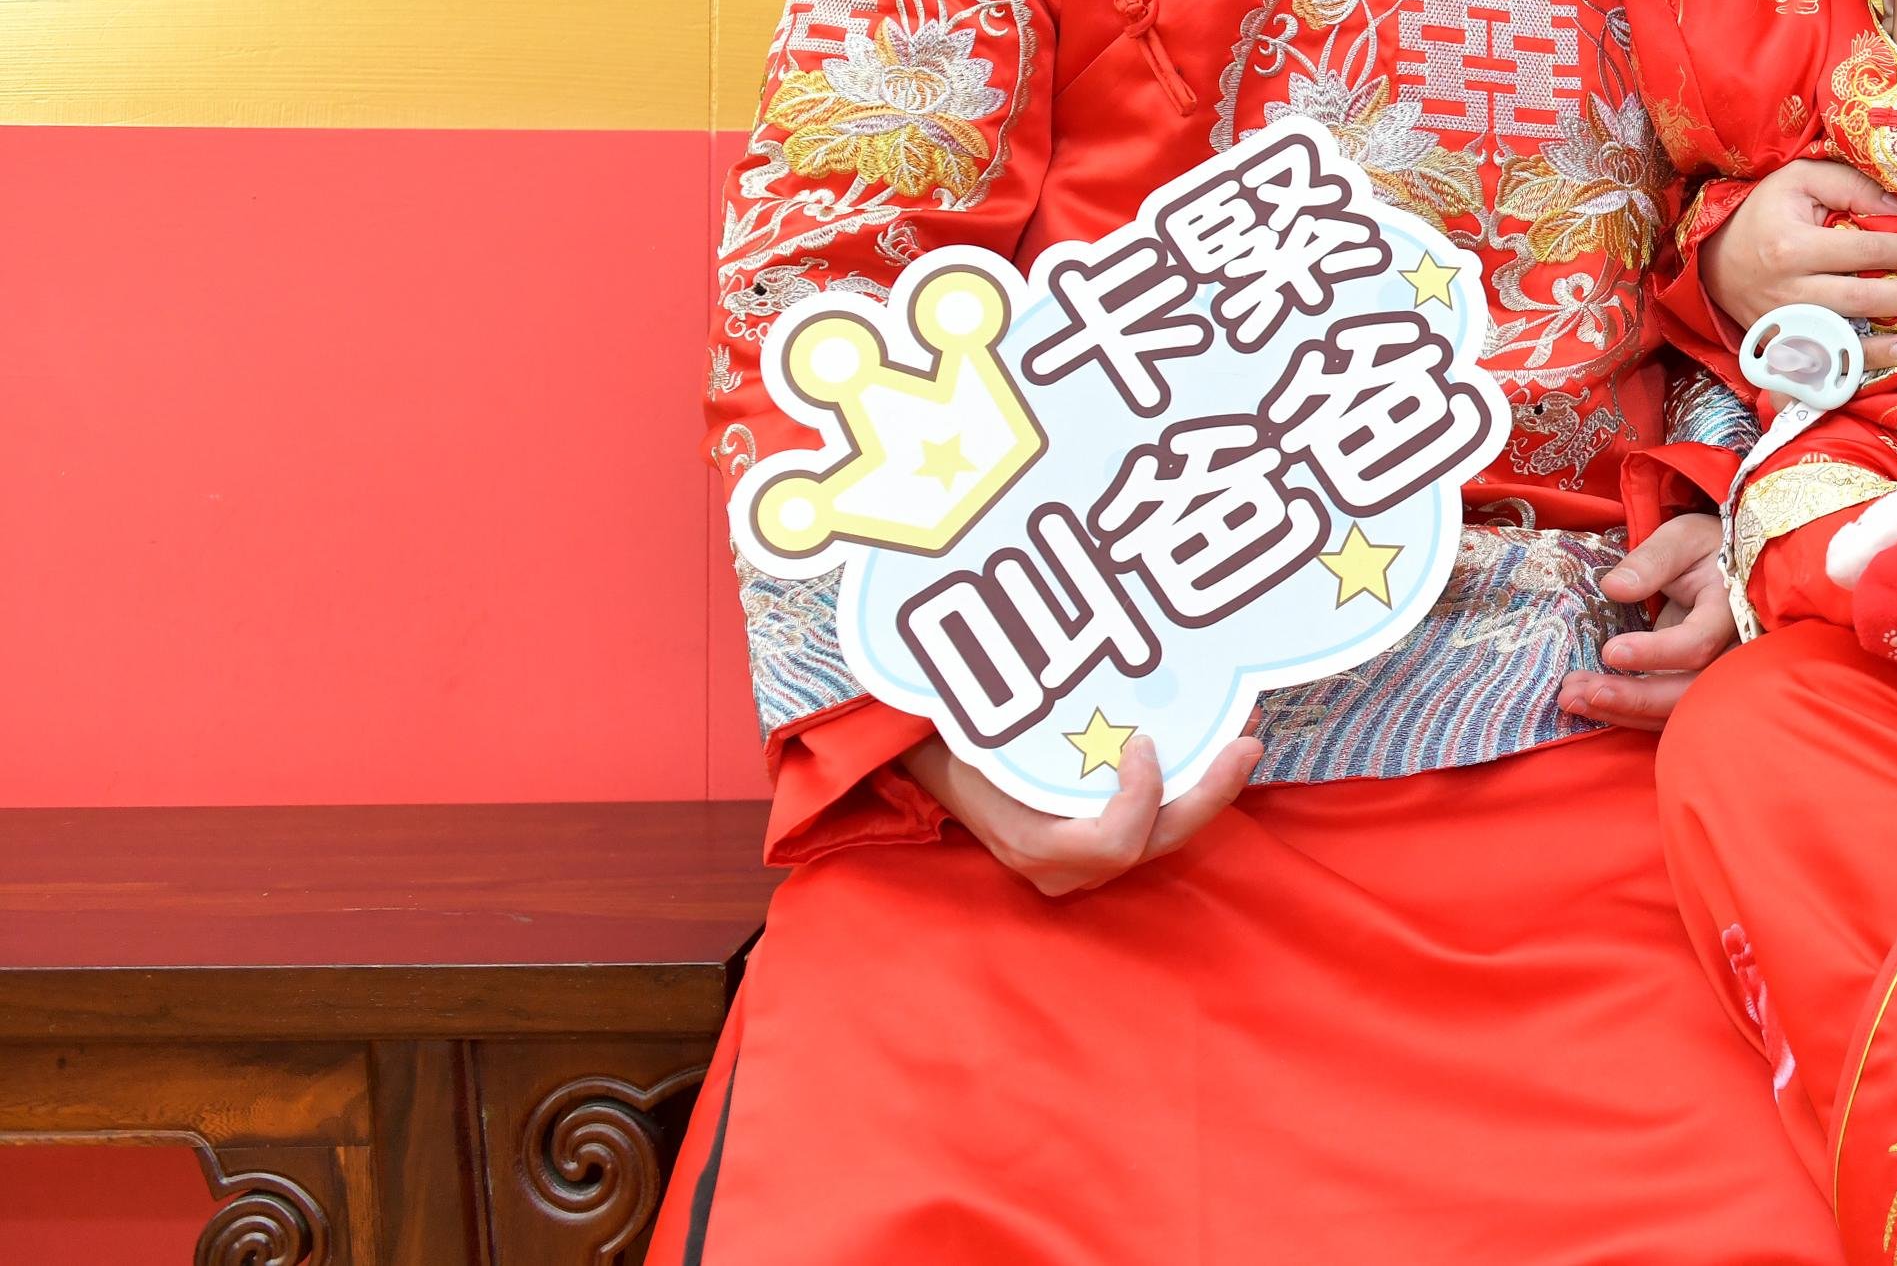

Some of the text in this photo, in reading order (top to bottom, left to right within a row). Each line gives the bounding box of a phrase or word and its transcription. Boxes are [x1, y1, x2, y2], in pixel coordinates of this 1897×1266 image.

[1021, 134, 1393, 418] 卡緊
[896, 311, 1493, 749] 叫爸爸
